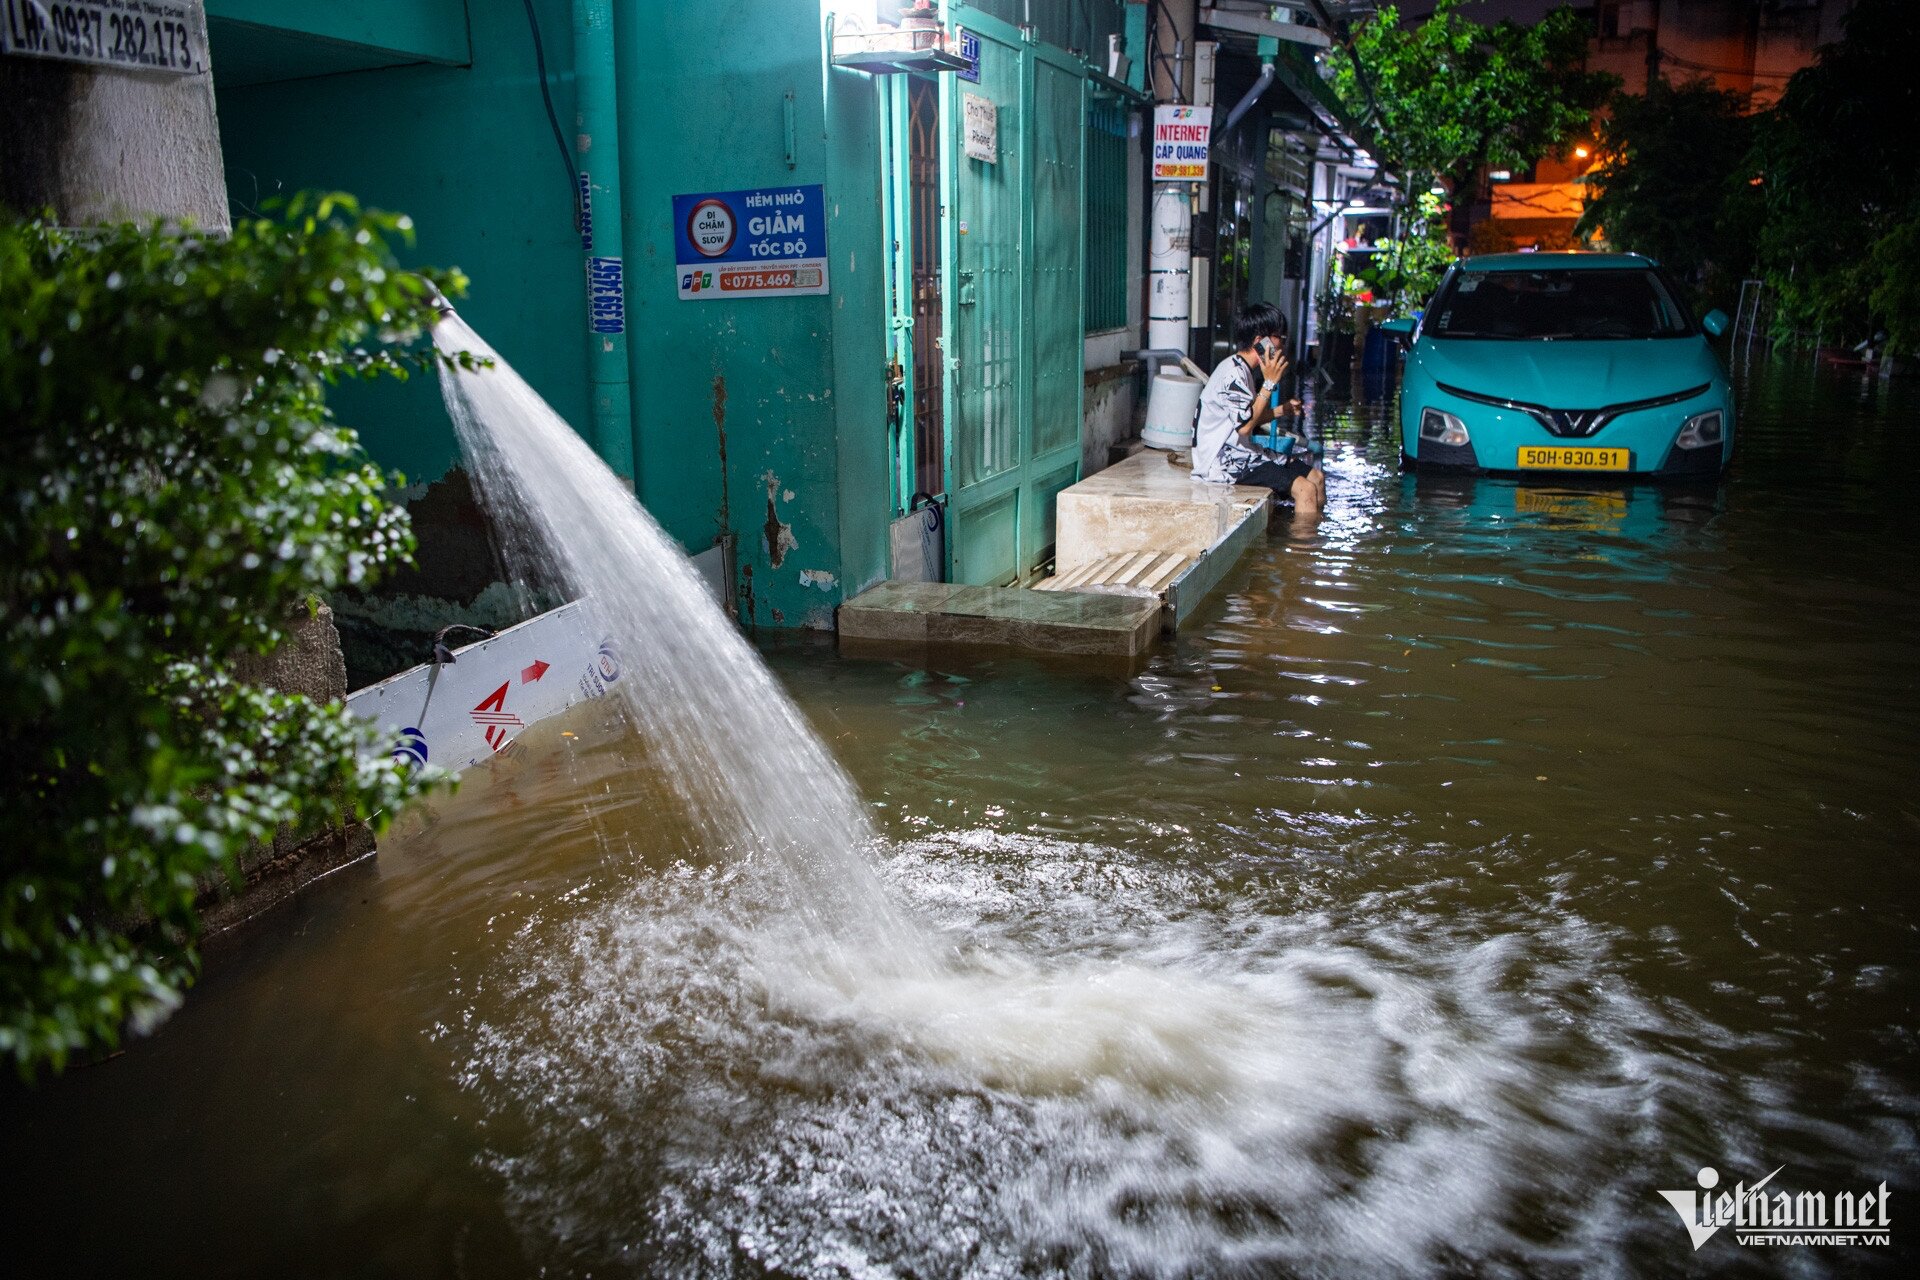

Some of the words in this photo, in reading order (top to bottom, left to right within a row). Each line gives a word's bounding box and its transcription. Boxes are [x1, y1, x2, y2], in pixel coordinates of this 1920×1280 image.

[51, 4, 192, 69] 0937.282.173
[1156, 125, 1208, 142] INTERNET
[1177, 145, 1207, 160] QUANG
[746, 192, 773, 208] HẺM
[776, 189, 804, 206] NHỎ
[706, 211, 716, 219] ĐI
[748, 210, 805, 236] GIẢM
[699, 220, 725, 231] CHẬM
[702, 236, 724, 244] SLOW
[750, 238, 781, 257] TỐC
[783, 238, 807, 258] ĐỘ
[682, 271, 713, 292] FPT
[1527, 450, 1618, 466] 50H-830.91
